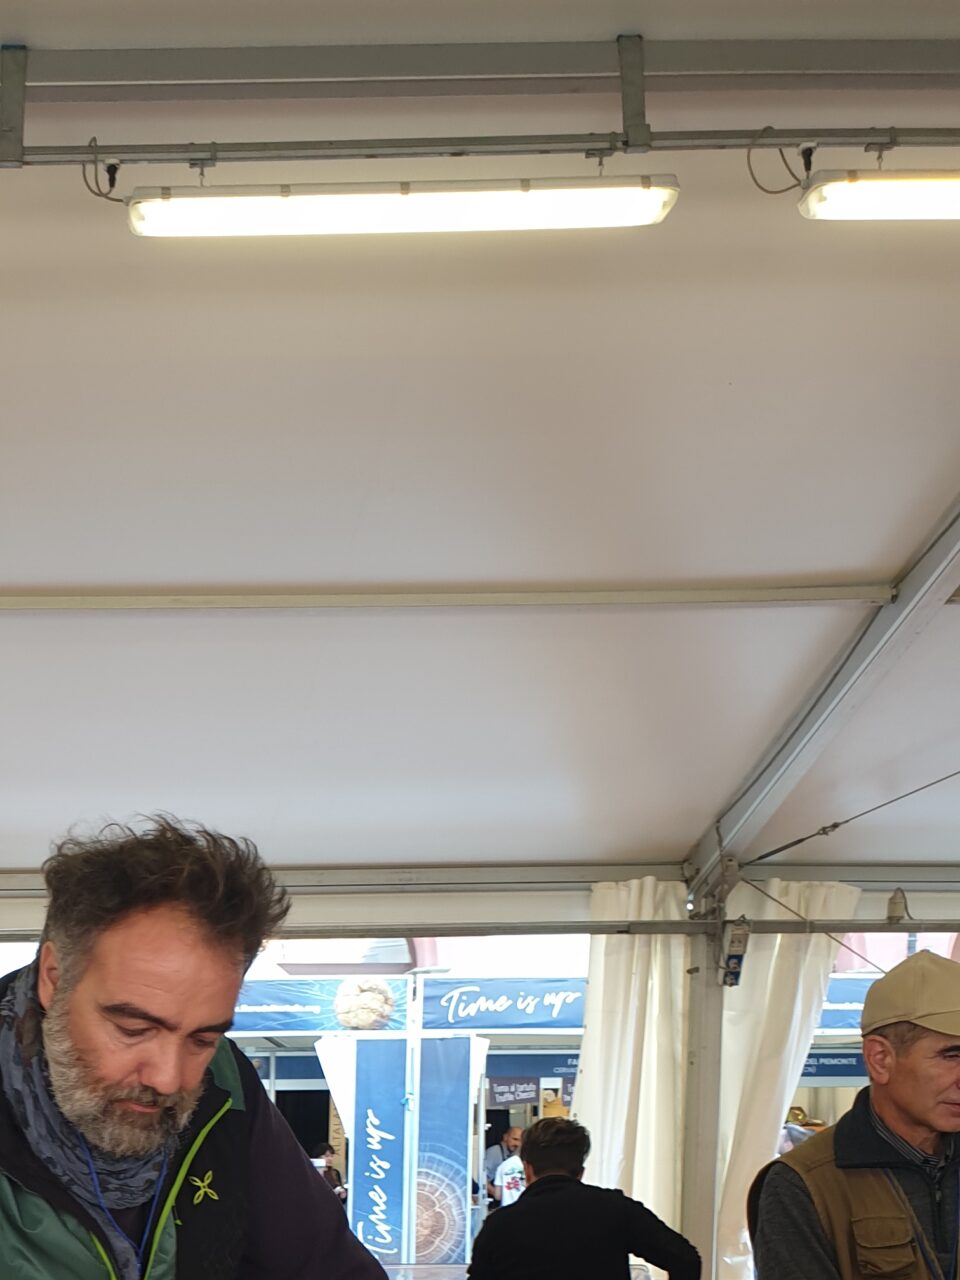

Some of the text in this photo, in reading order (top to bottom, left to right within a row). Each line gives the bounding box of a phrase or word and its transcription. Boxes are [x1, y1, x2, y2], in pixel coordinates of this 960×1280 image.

[440, 986, 582, 1023] Time is up
[357, 1108, 398, 1258] Time is up
